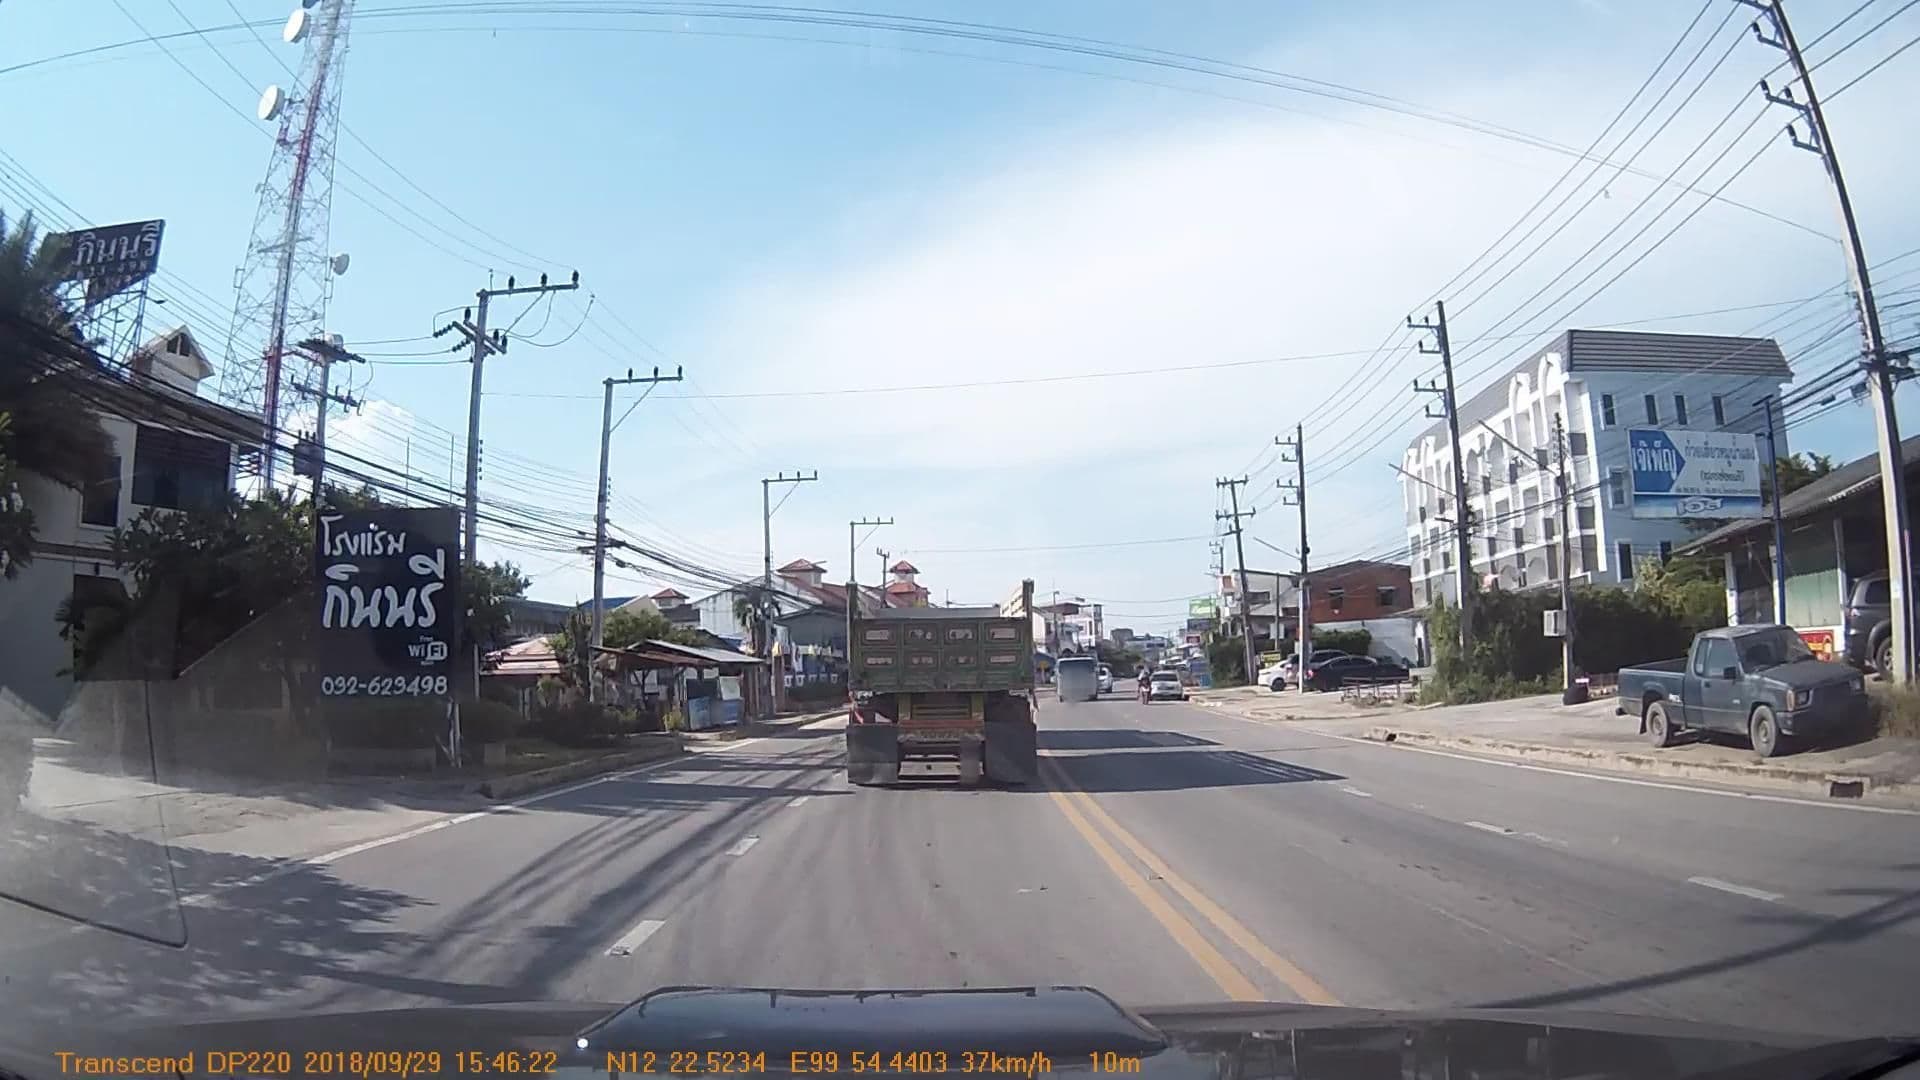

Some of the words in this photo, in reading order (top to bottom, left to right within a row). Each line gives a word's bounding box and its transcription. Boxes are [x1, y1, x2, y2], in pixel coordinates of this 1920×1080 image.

[72, 221, 160, 266] กินนรี
[320, 514, 406, 556] โรงแรม
[323, 549, 445, 628] กินนรี
